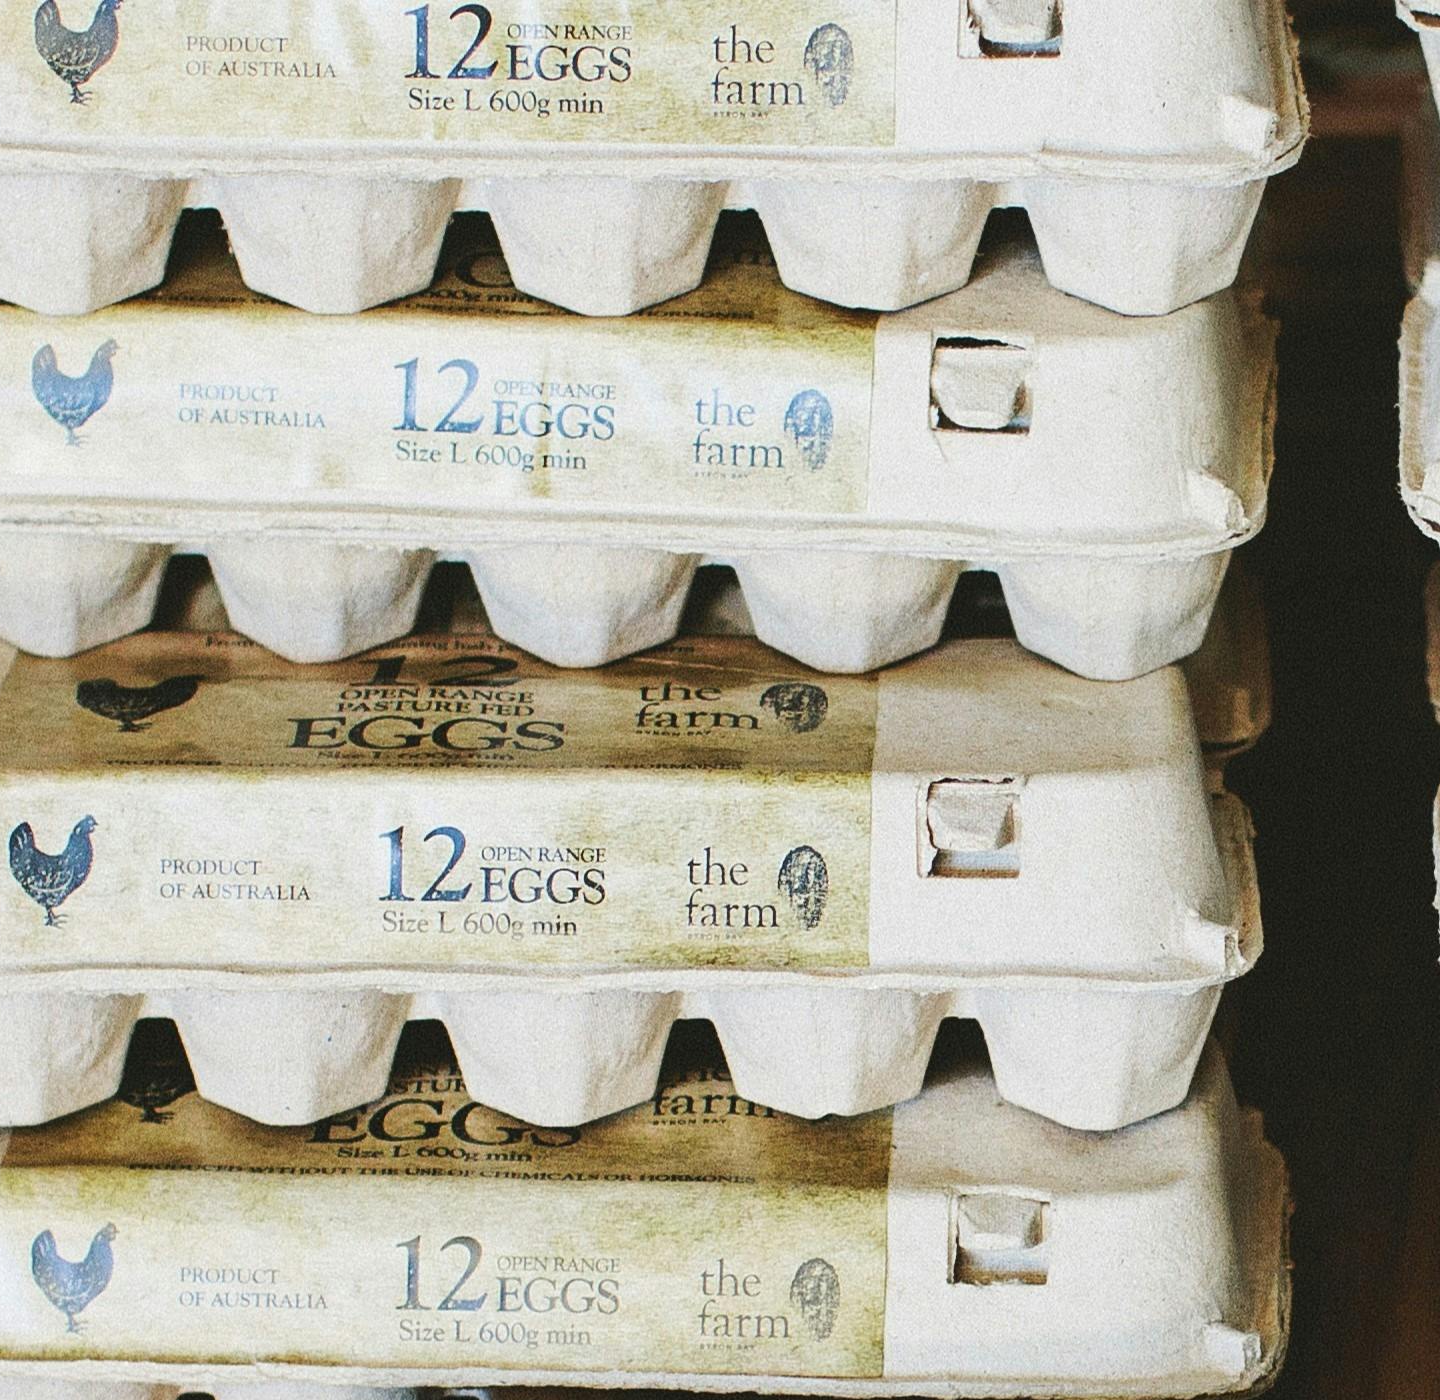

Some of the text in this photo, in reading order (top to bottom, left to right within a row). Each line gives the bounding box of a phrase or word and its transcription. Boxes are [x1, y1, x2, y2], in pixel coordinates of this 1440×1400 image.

[187, 36, 288, 53] PRODUCT
[404, 4, 498, 80] 12
[507, 24, 633, 40] OPEN RANGE
[713, 25, 774, 64] the
[186, 61, 336, 78] OF AUSTRALIA
[506, 45, 631, 83] EGGS
[711, 67, 805, 106] farm
[409, 88, 603, 118] Size L 600g min
[179, 383, 278, 402] PRODUCT
[392, 357, 484, 434] 12
[494, 380, 616, 400] OPEN RANGE
[178, 408, 325, 428] OF AUSTRALIA
[492, 400, 615, 440] EGGS
[696, 387, 755, 427] the
[396, 440, 586, 472] Size L 600g min
[693, 430, 784, 469] farm
[351, 655, 522, 688] 12
[340, 687, 535, 703] OPEN RANGE
[640, 682, 722, 701] the
[338, 701, 535, 716] PASTURE FED
[635, 703, 761, 730] farm
[287, 715, 565, 751] EGGS
[161, 859, 262, 875] PRODUCT
[379, 825, 473, 901] 12
[481, 846, 606, 863] OPEN RANGE
[687, 847, 749, 886] the
[160, 884, 310, 900] OF AUSTRALIA
[480, 867, 605, 905] EGGS
[686, 889, 779, 928] farm
[383, 911, 577, 941] Size L 600g min
[337, 1146, 532, 1162] Size L 600g min
[180, 1267, 280, 1284] PRODUCT
[396, 1235, 488, 1311] 12
[497, 1256, 620, 1273] OPEN RANGE
[701, 1258, 761, 1297] the
[179, 1291, 328, 1310] OF AUSTRALIA
[496, 1276, 620, 1314] EGGS
[399, 1320, 591, 1349] Size L 600g min
[698, 1300, 789, 1339] farm
